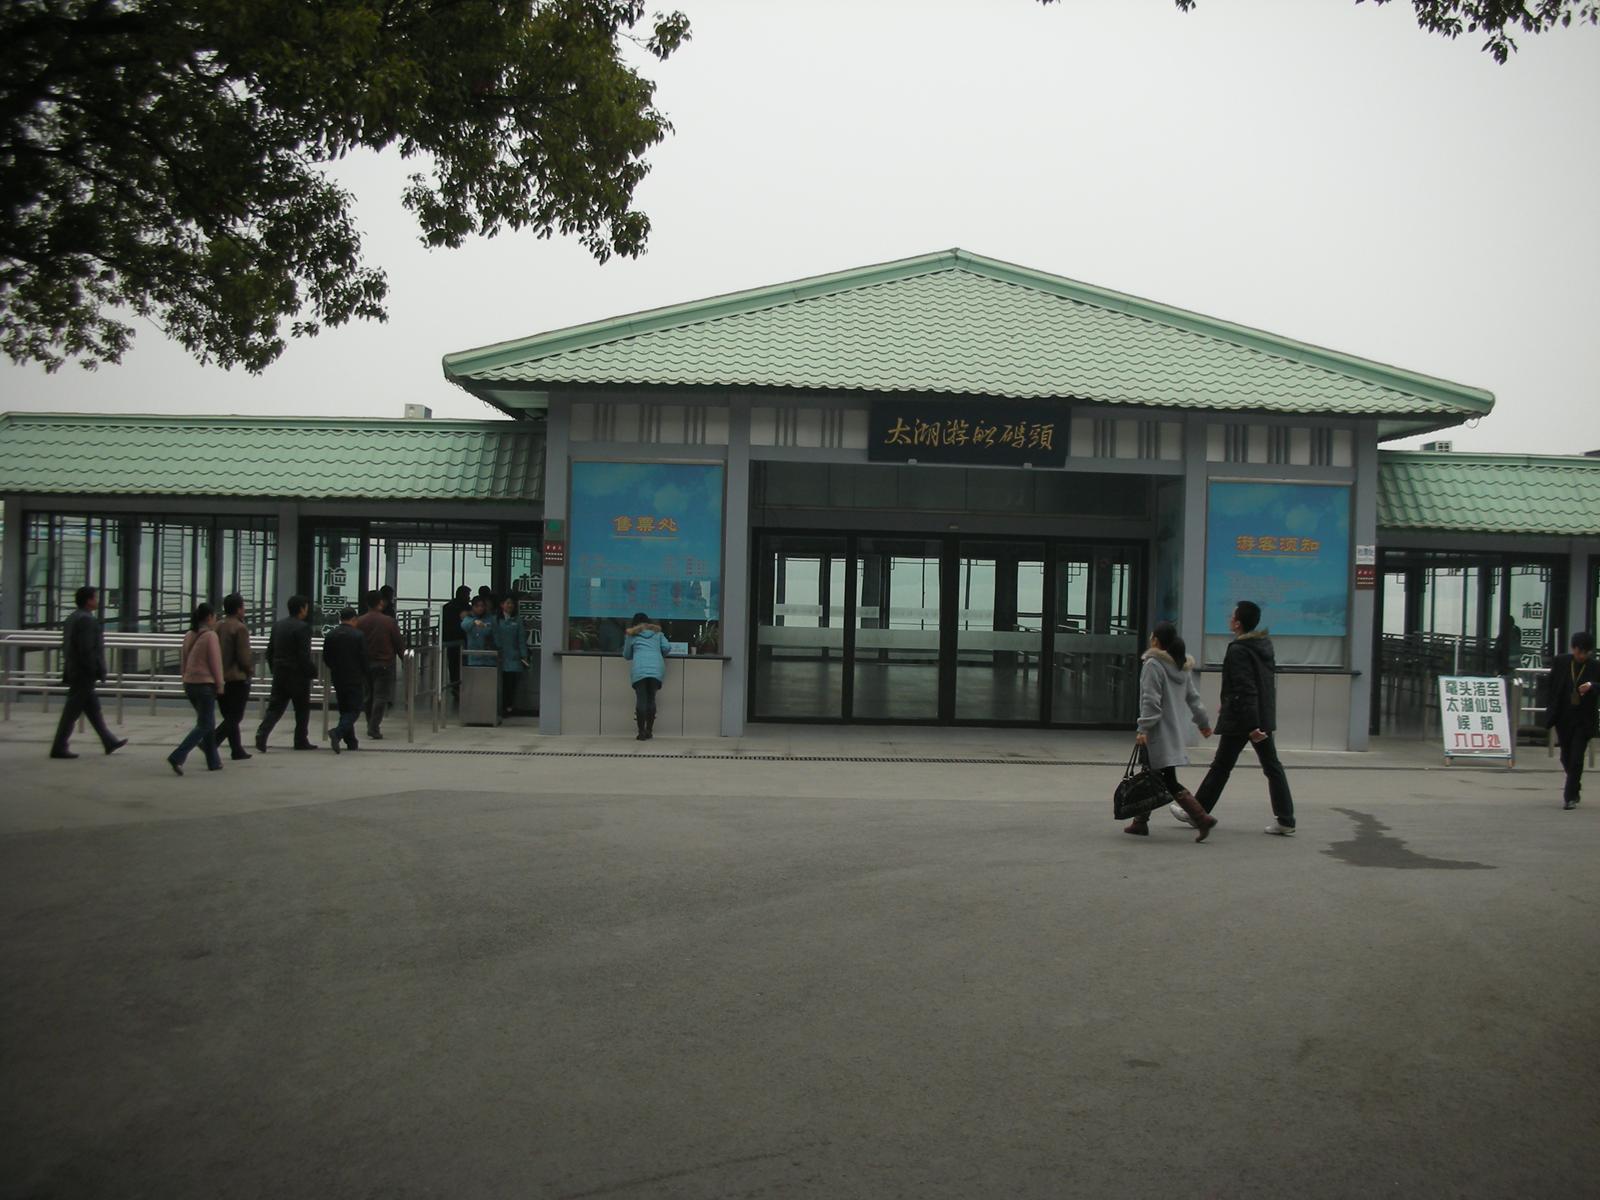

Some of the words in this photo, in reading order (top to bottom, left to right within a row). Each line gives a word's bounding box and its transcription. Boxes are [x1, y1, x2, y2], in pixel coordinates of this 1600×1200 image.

[613, 514, 678, 532] 售票处
[1236, 535, 1319, 551] 游客须知
[1520, 602, 1543, 668] 检票处
[1446, 697, 1501, 713] 太湖仙岛
[1454, 733, 1501, 748] 入口处
